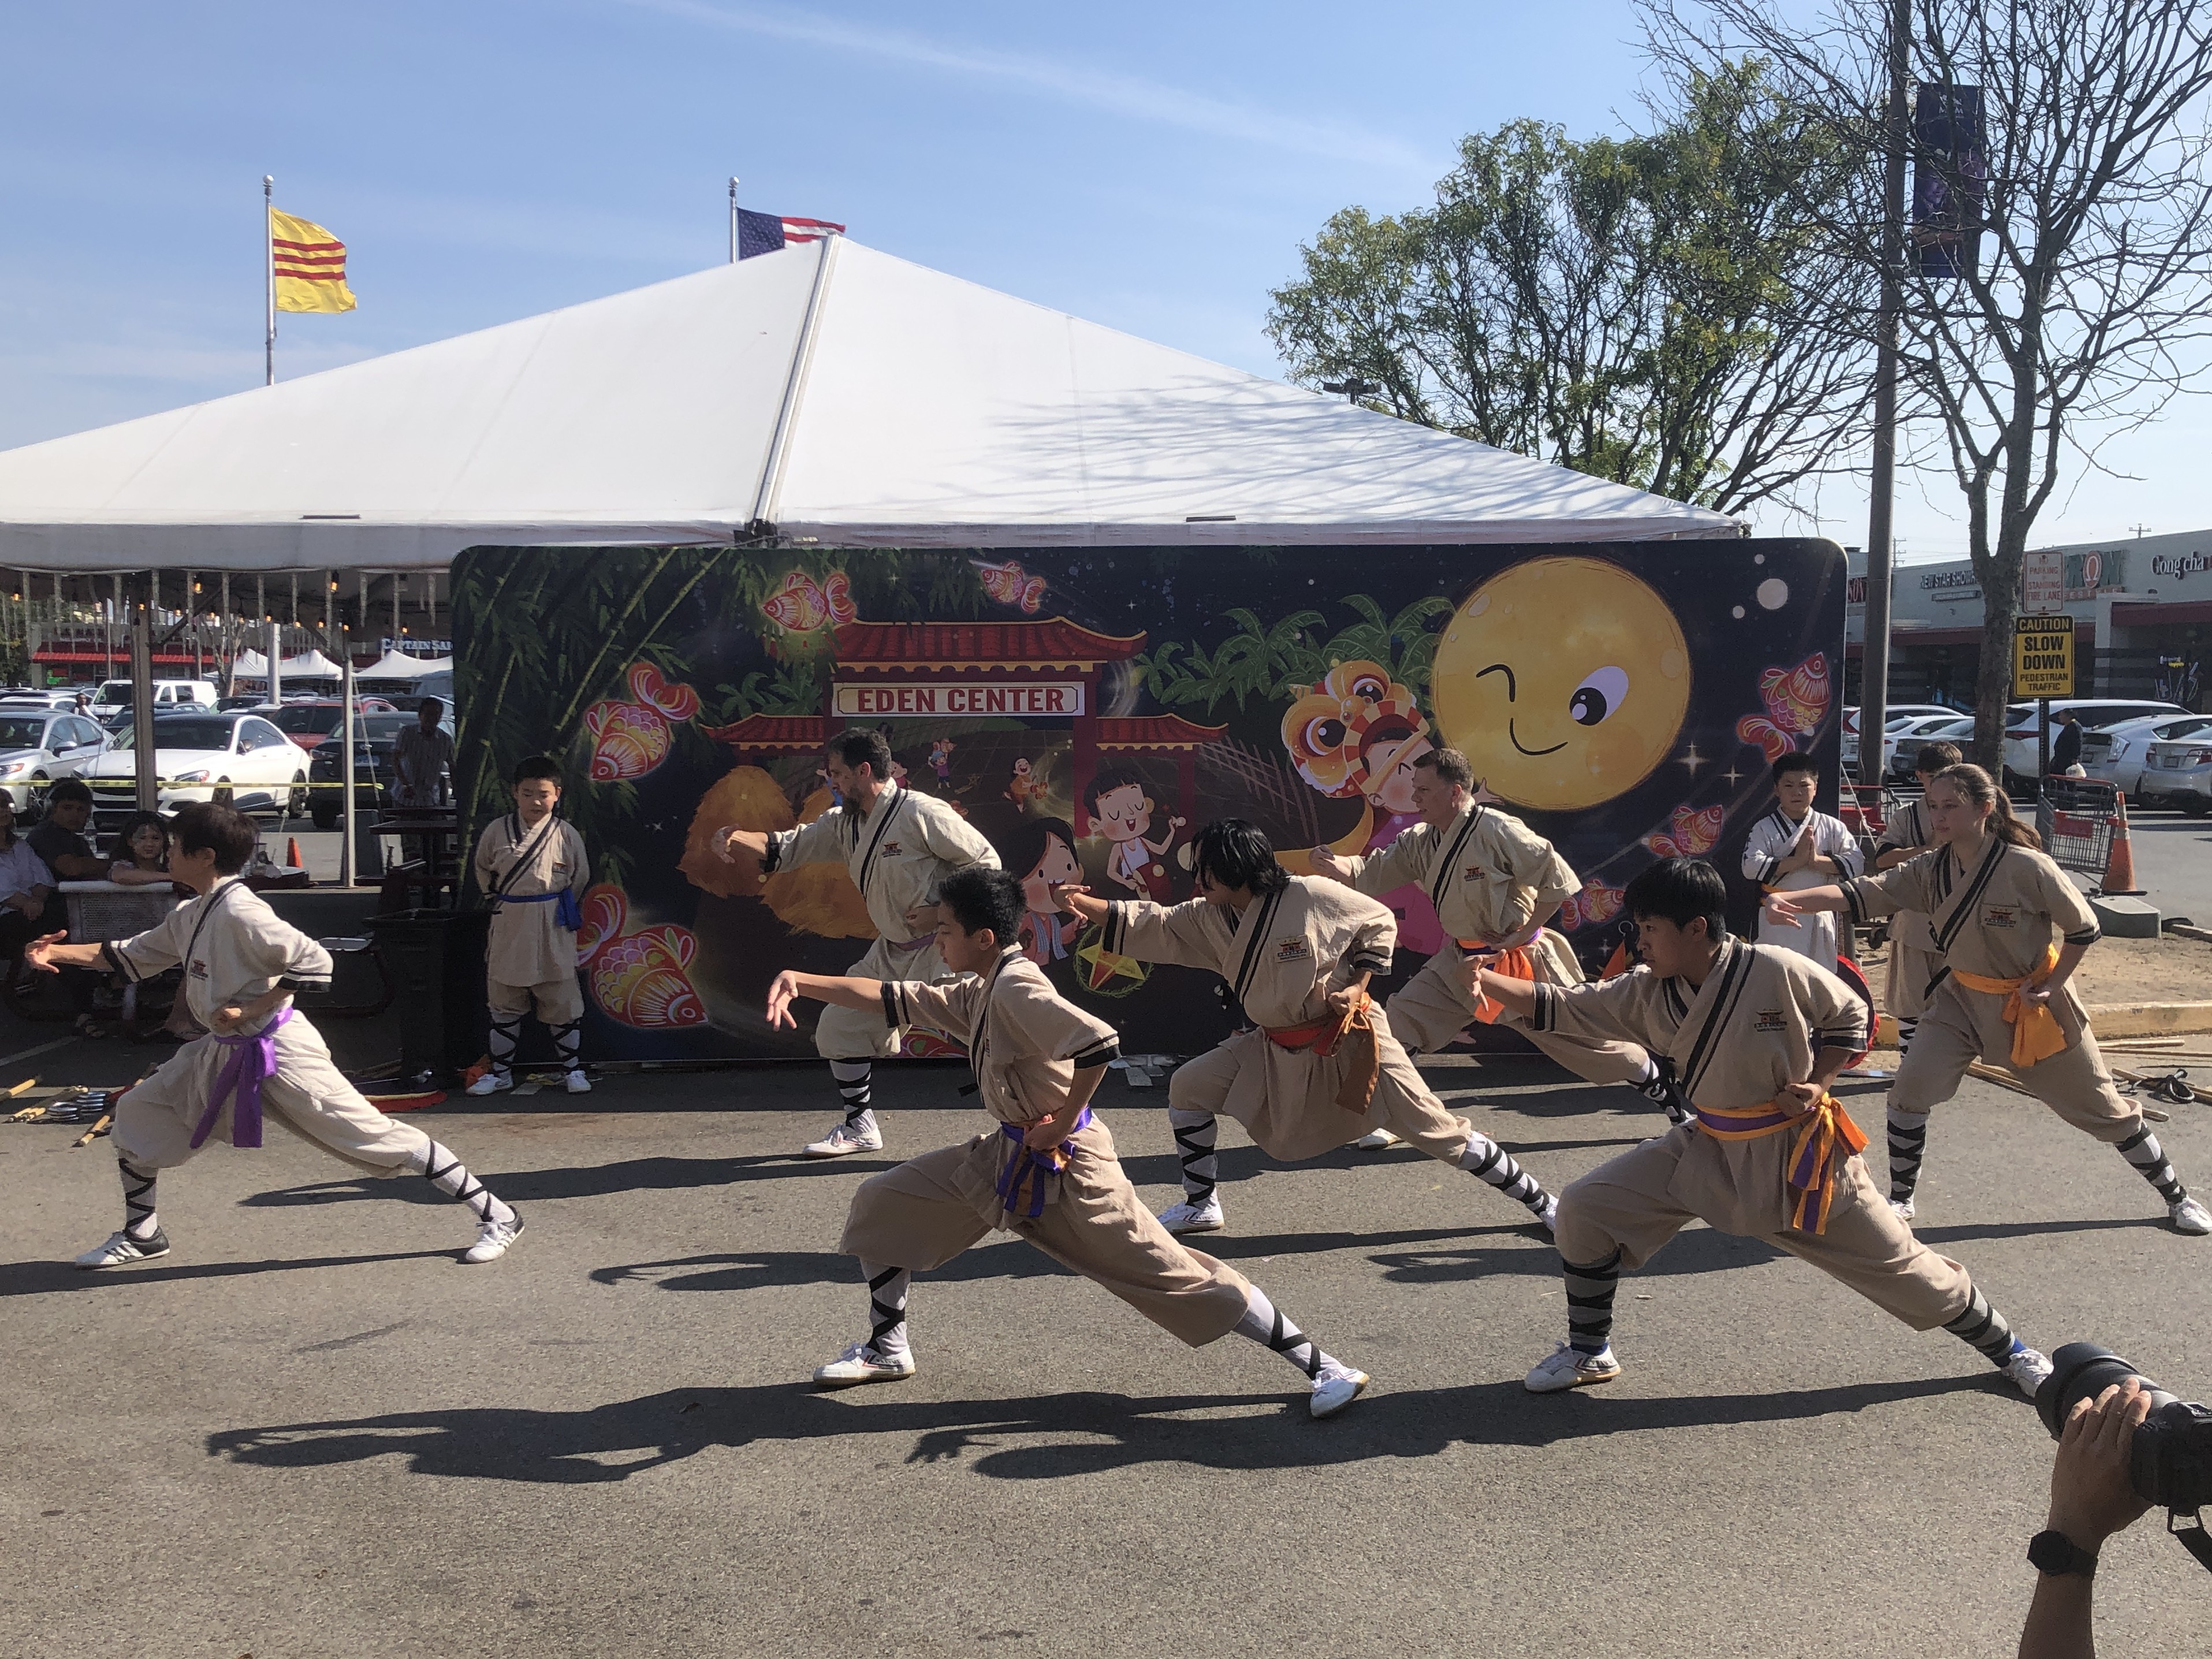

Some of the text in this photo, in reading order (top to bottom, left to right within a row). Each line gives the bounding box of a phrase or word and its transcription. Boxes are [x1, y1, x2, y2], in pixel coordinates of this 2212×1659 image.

[2150, 550, 2204, 579] Gong cha
[1935, 572, 1952, 587] STAR
[2044, 591, 2061, 601] LANE
[2019, 618, 2069, 631] CAUTION
[431, 640, 453, 650] SAI
[2024, 636, 2064, 652] SLOW
[2023, 654, 2065, 669] DOWN
[2020, 673, 2068, 682] PEDESTRIAN
[2028, 682, 2061, 691] TRAFFIC
[858, 689, 1064, 712] EDEN CENTER
